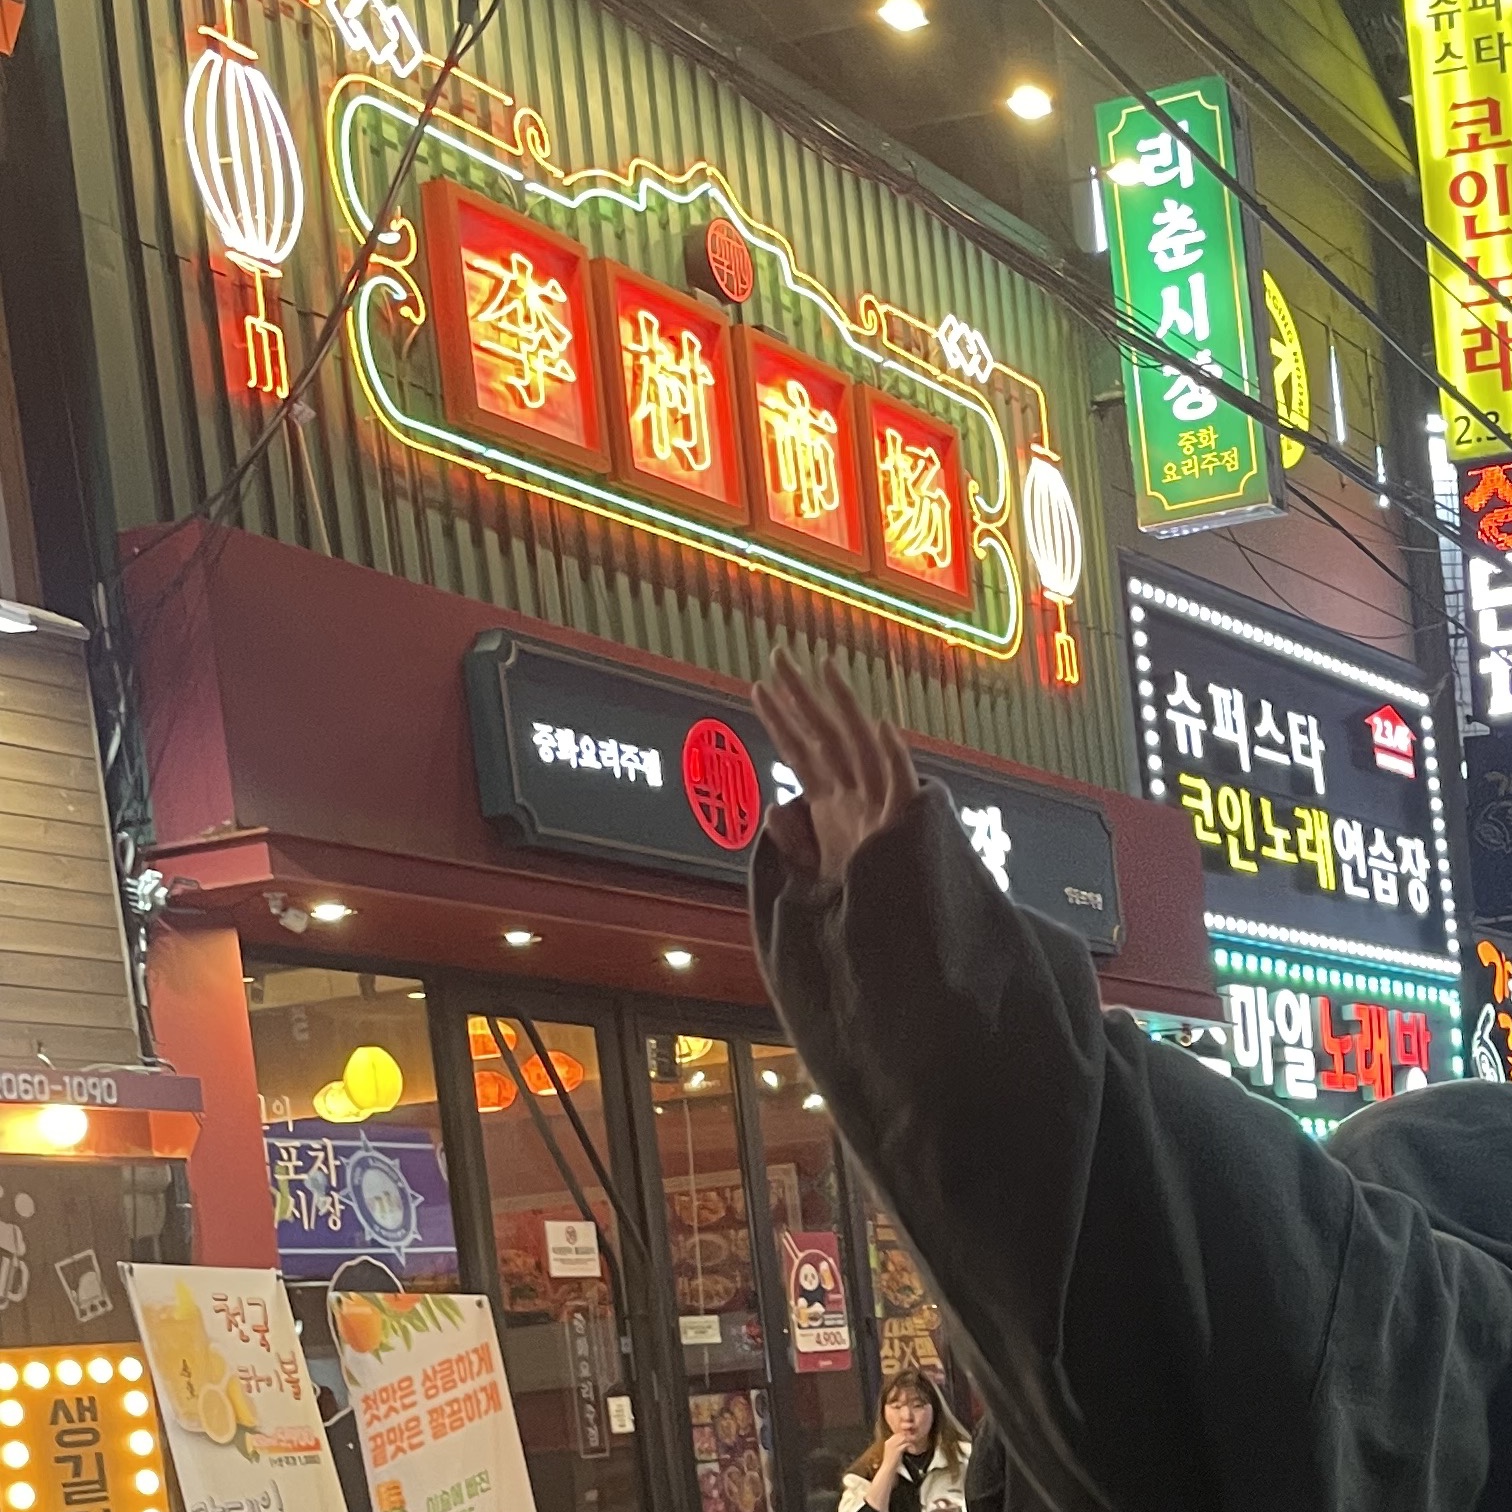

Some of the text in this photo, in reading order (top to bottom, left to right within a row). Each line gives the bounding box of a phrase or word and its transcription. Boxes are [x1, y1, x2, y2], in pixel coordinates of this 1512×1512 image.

[1432, 31, 1512, 76] 스타
[1178, 426, 1219, 455] 중화
[1161, 447, 1241, 485] 요리주점
[1165, 670, 1326, 796] 슈퍼스타
[1, 1071, 118, 1104] 060-1090
[361, 1341, 495, 1428] 첫맛은 상큼하게
